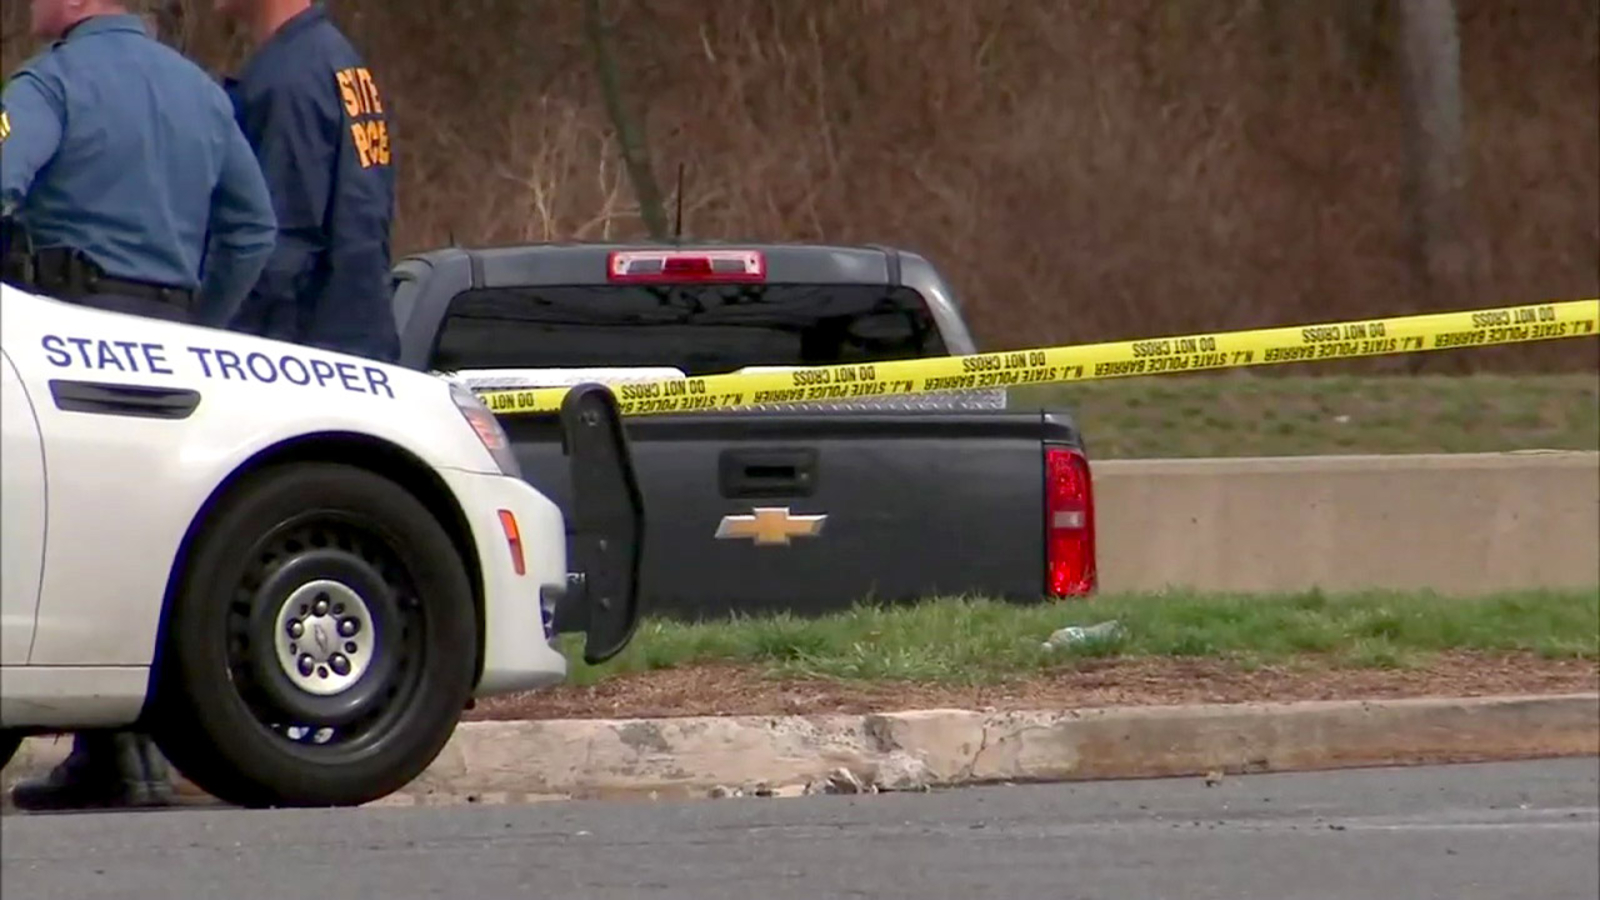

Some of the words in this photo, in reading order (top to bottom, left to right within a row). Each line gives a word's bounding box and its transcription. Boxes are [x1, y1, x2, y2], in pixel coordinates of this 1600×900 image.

[336, 67, 382, 117] STE
[351, 120, 390, 168] PCE
[1472, 311, 1511, 328] CROSS
[1514, 309, 1536, 324] NOT
[1539, 307, 1556, 321] DO
[1344, 324, 1366, 340] NOT
[1369, 322, 1386, 337] DO
[1488, 325, 1529, 342] POLICE
[1531, 322, 1566, 338] STATE
[1570, 319, 1594, 333] N.J.
[1302, 326, 1340, 343] CROSS
[1400, 336, 1425, 349] N.J.
[1434, 329, 1486, 347] BARRIER
[1132, 339, 1171, 357] CROSS
[1175, 338, 1197, 354] NOT
[1199, 337, 1216, 351] DO
[1317, 340, 1359, 357] POLICE
[1361, 337, 1397, 352] STATE
[1004, 352, 1027, 369] NOT
[1029, 351, 1046, 367] DO
[1191, 350, 1226, 367] STATE
[1230, 349, 1254, 363] N.J.
[1264, 344, 1315, 361] BARRIER
[41, 334, 174, 375] STATE
[186, 346, 395, 399] TROOPER
[963, 355, 1001, 372] CROSS
[1060, 364, 1083, 379] N.J.
[1095, 358, 1145, 376] BARRIER
[1148, 356, 1188, 372] POLICE
[793, 369, 830, 386] CROSS
[833, 366, 856, 382] NOT
[859, 365, 876, 381] DO
[974, 371, 1017, 388] POLICE
[1020, 367, 1056, 382] STATE
[663, 380, 686, 396] NOT
[690, 379, 706, 393] DO
[851, 381, 886, 396] STATE
[889, 379, 914, 393] N.J.
[924, 374, 975, 390] BARRIER
[621, 382, 660, 399] CROSS
[753, 388, 804, 403] BARRIER
[806, 385, 849, 400] POLICE
[491, 394, 515, 409] NOT
[517, 392, 534, 408] DO
[637, 398, 678, 412] POLICE
[681, 395, 717, 408] STATE
[720, 393, 743, 406] N.J.
